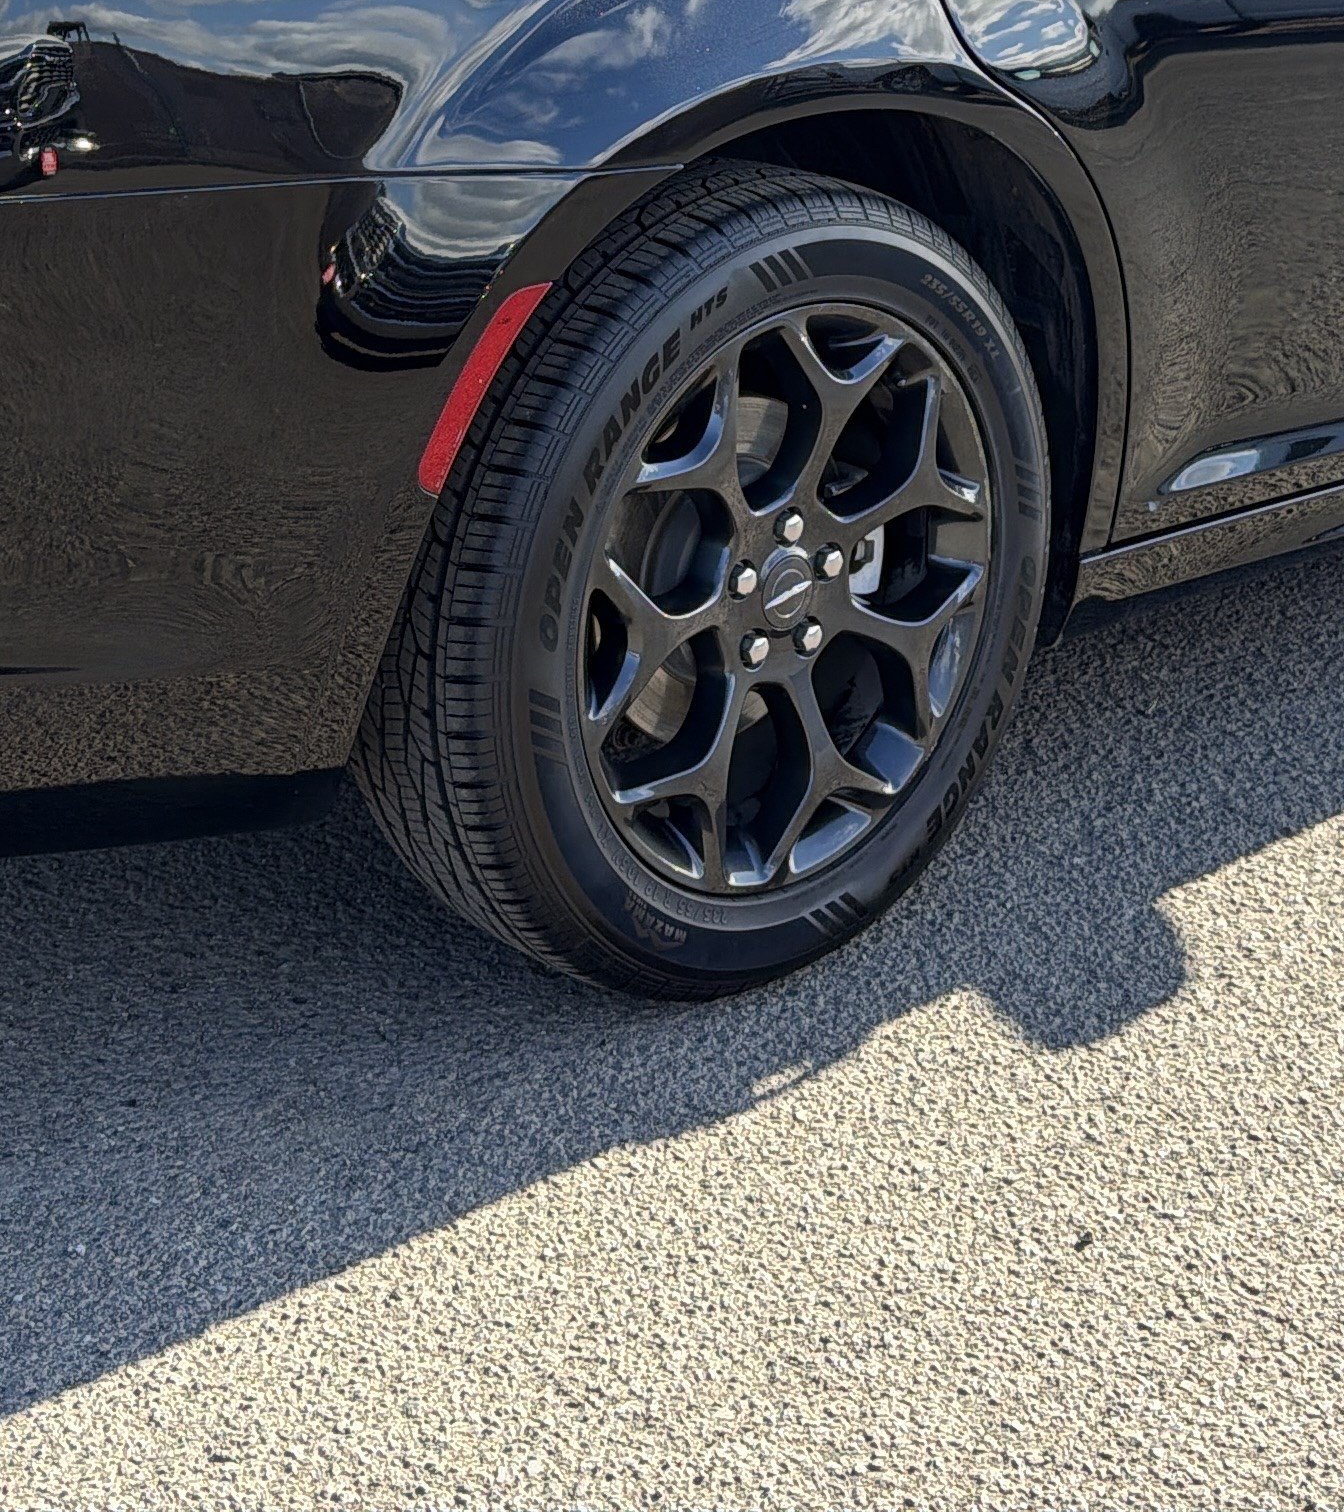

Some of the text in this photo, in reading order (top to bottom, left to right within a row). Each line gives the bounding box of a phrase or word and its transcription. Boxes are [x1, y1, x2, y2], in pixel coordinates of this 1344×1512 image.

[539, 285, 729, 653] OPEN RANGE HTS
[926, 688, 1004, 844] RANGE
